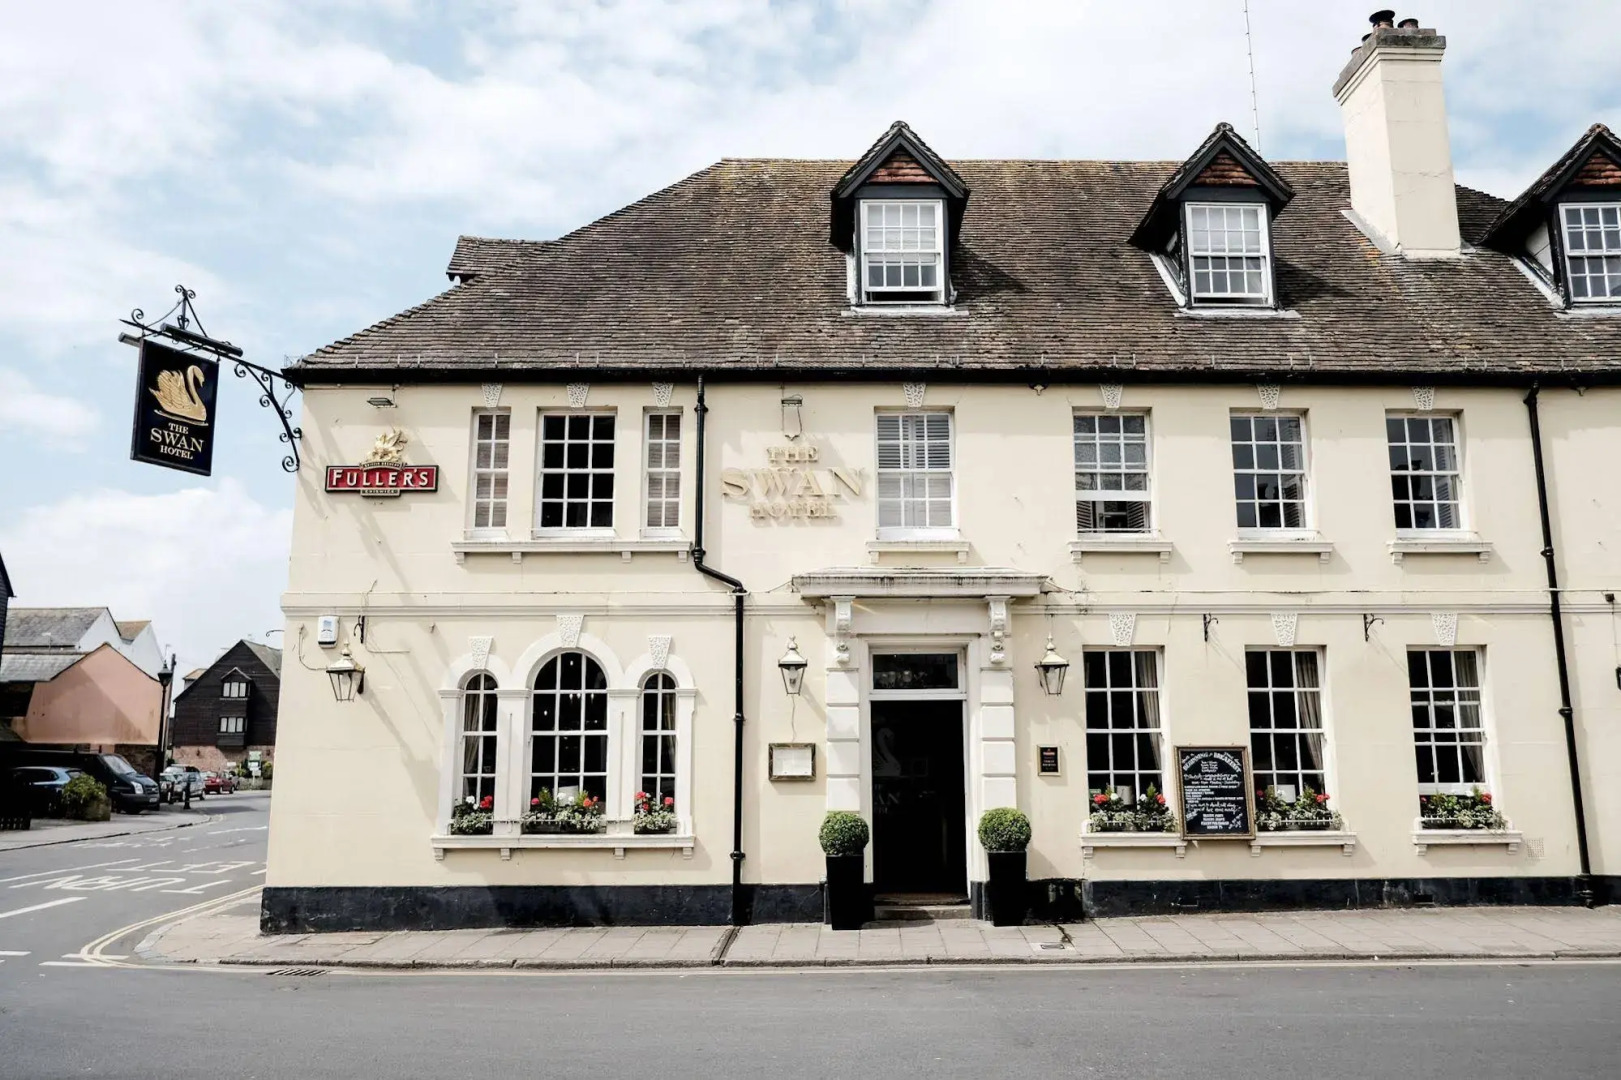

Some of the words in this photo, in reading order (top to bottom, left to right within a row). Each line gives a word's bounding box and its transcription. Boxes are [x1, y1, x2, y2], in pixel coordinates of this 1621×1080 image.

[168, 422, 189, 435] THE
[150, 427, 205, 453] SWAN
[160, 445, 194, 460] HOTEL
[766, 446, 819, 463] THE
[332, 468, 429, 488] FULLER'S
[721, 467, 865, 498] SWAN
[750, 502, 838, 520] HOTEL
[8, 875, 233, 895] TURN
